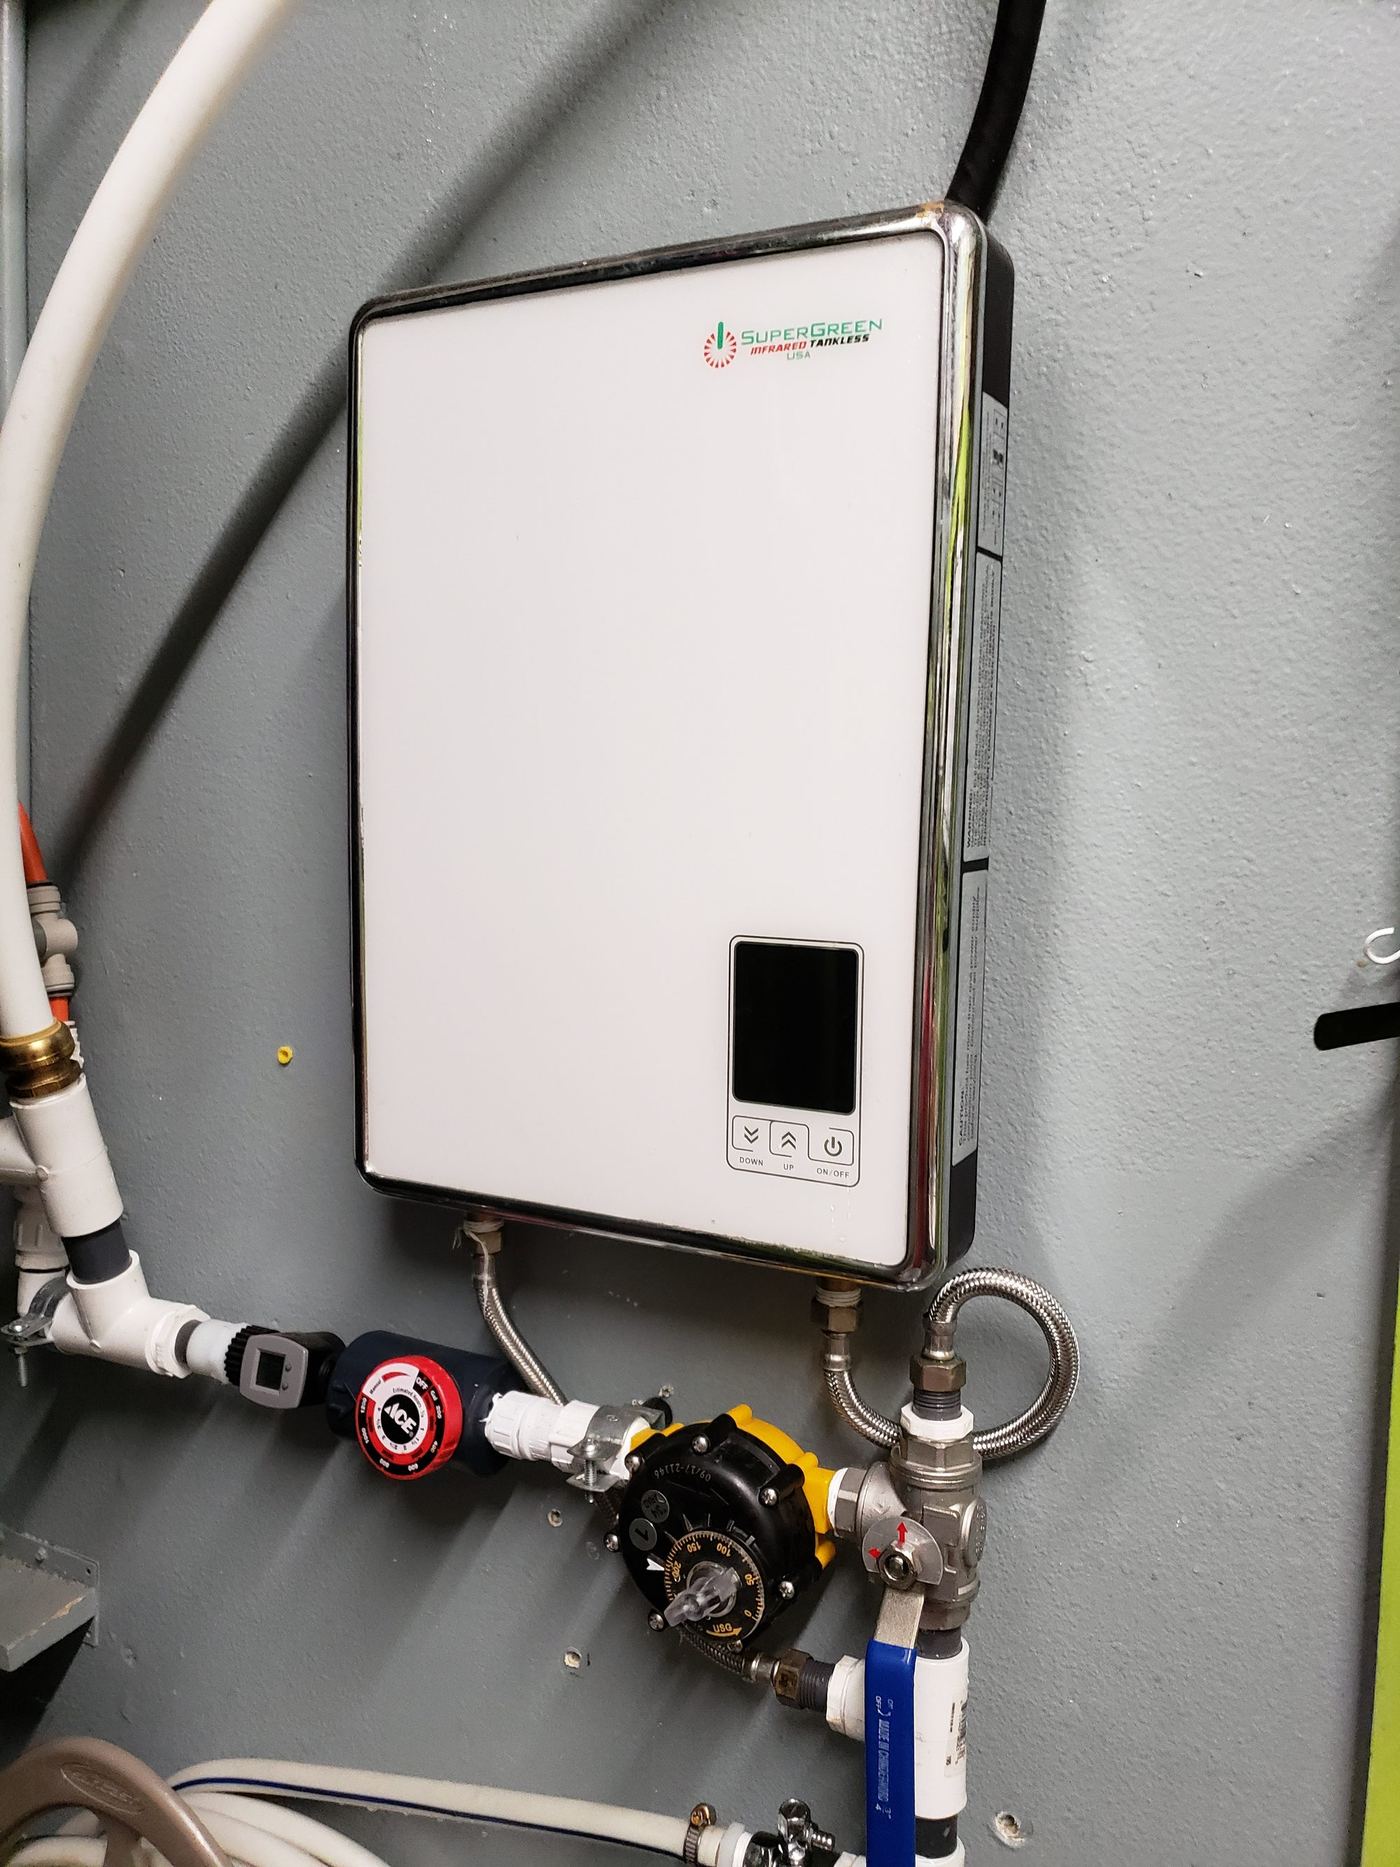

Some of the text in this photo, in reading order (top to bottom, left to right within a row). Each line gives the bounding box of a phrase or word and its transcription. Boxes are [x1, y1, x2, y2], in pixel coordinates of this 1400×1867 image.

[750, 334, 870, 355] INFRARED TANKLESS
[787, 351, 811, 360] USA
[739, 1157, 764, 1166] DOWN
[783, 1163, 794, 1171] UP
[816, 1168, 850, 1179] ON/OFF
[415, 1376, 428, 1390] OFF
[430, 1390, 438, 1400] Gal
[384, 1402, 417, 1434] ACE
[687, 1542, 702, 1553] 150
[717, 1543, 731, 1557] 100
[744, 1573, 754, 1586] 50
[744, 1609, 752, 1618] 0
[713, 1623, 733, 1632] USG
